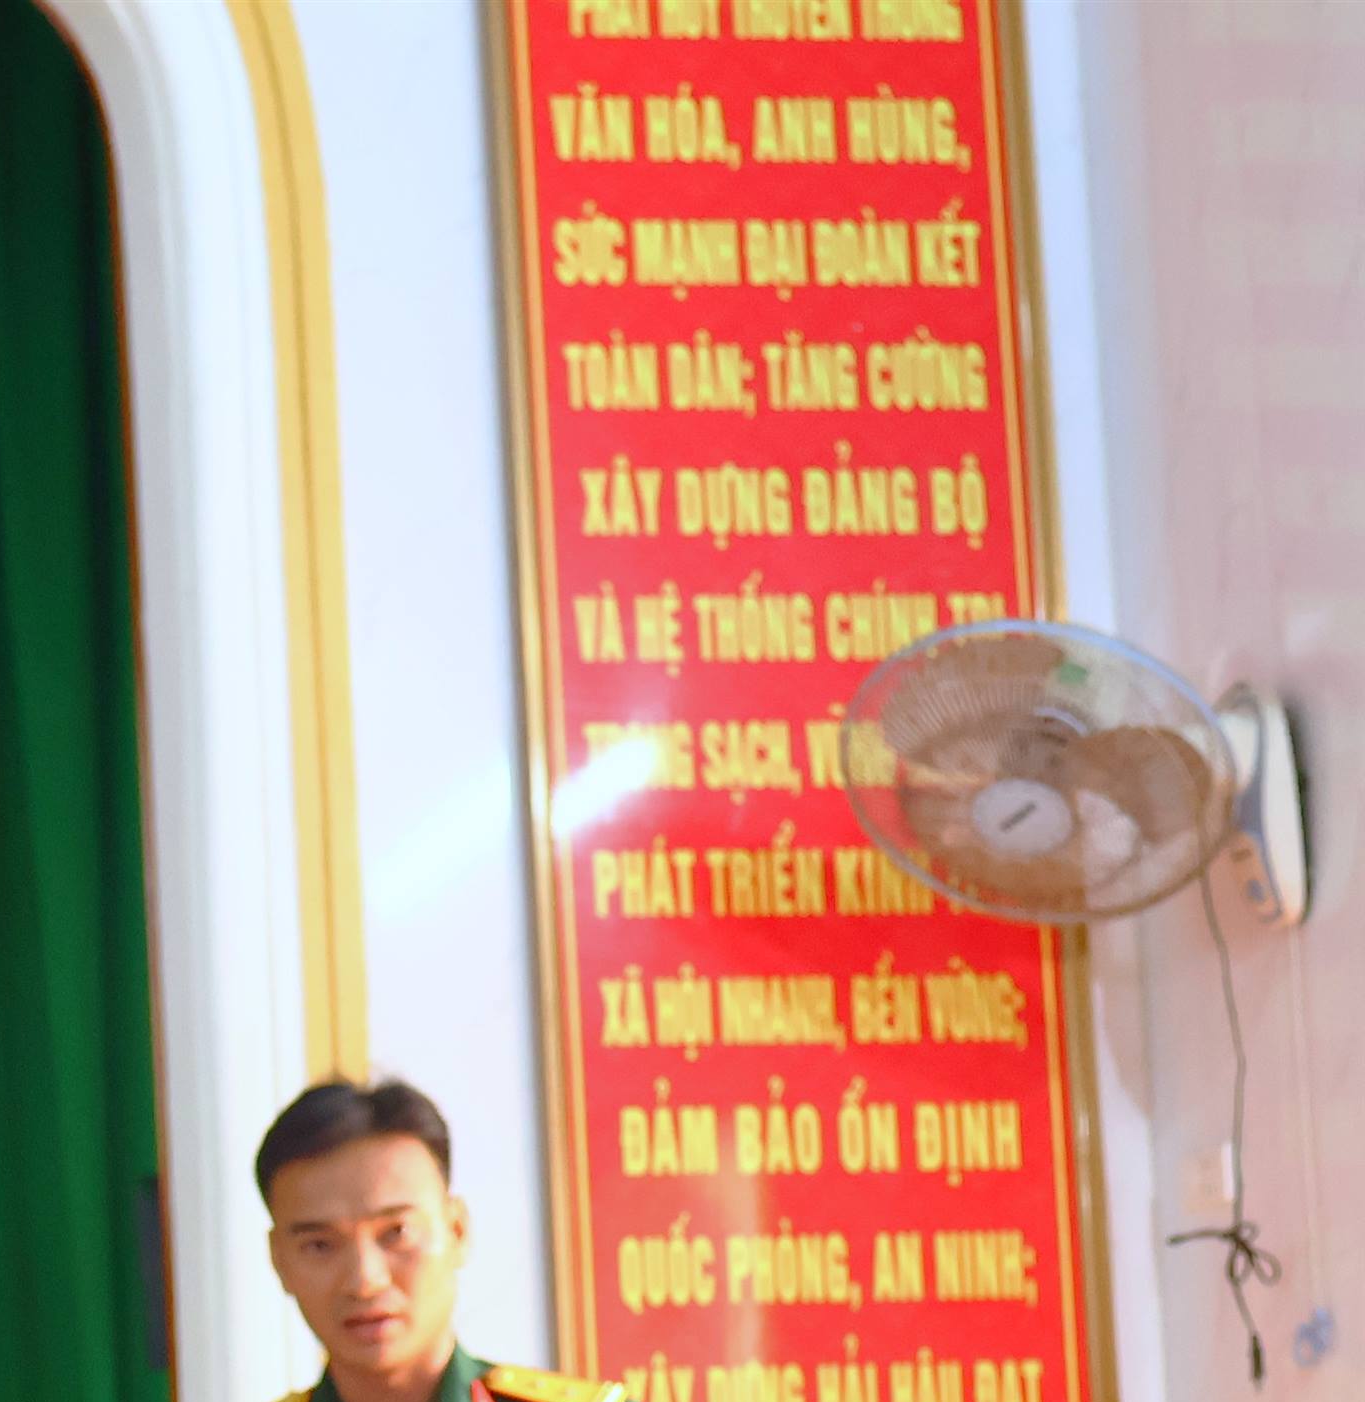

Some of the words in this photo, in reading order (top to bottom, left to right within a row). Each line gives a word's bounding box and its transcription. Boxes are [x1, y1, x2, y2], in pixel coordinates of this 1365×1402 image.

[549, 81, 634, 162] VĂN
[643, 81, 742, 170] HÓA,
[753, 96, 837, 163] ANH
[847, 83, 972, 173] HÙNG,
[553, 200, 626, 287] SỨC
[633, 218, 740, 301] MẠNH
[745, 219, 808, 301] ĐẠI
[813, 205, 912, 287] ĐOÀN
[916, 197, 980, 287] KẾT
[562, 328, 659, 411] TOÀN
[667, 328, 757, 419] DÂN;
[763, 329, 859, 410] TĂNG
[868, 325, 988, 411] CƯỜNG
[579, 454, 662, 536] XÂY
[676, 461, 793, 550] DỰNG
[802, 439, 919, 536] ĐẢNG
[929, 453, 988, 550] BỘ
[573, 580, 625, 663] VÀ
[634, 580, 684, 678] HỆ
[694, 569, 816, 663] THỐNG
[825, 578, 938, 662] CHÍNH
[701, 719, 803, 806] SẠCH,
[591, 833, 696, 919] PHÁT
[705, 818, 826, 917] TRIỂN
[598, 963, 650, 1047] XÃ
[653, 961, 714, 1062] HỘI
[619, 1076, 718, 1177] ĐẢM
[733, 1074, 822, 1174] BẢO
[836, 1074, 900, 1174] ỔN
[913, 1099, 1022, 1187] ĐỊNH
[618, 1210, 716, 1315] QUỐC
[726, 1216, 863, 1311] PHÒNG,
[873, 1229, 925, 1304] AN
[933, 1229, 1038, 1309] NINH;
